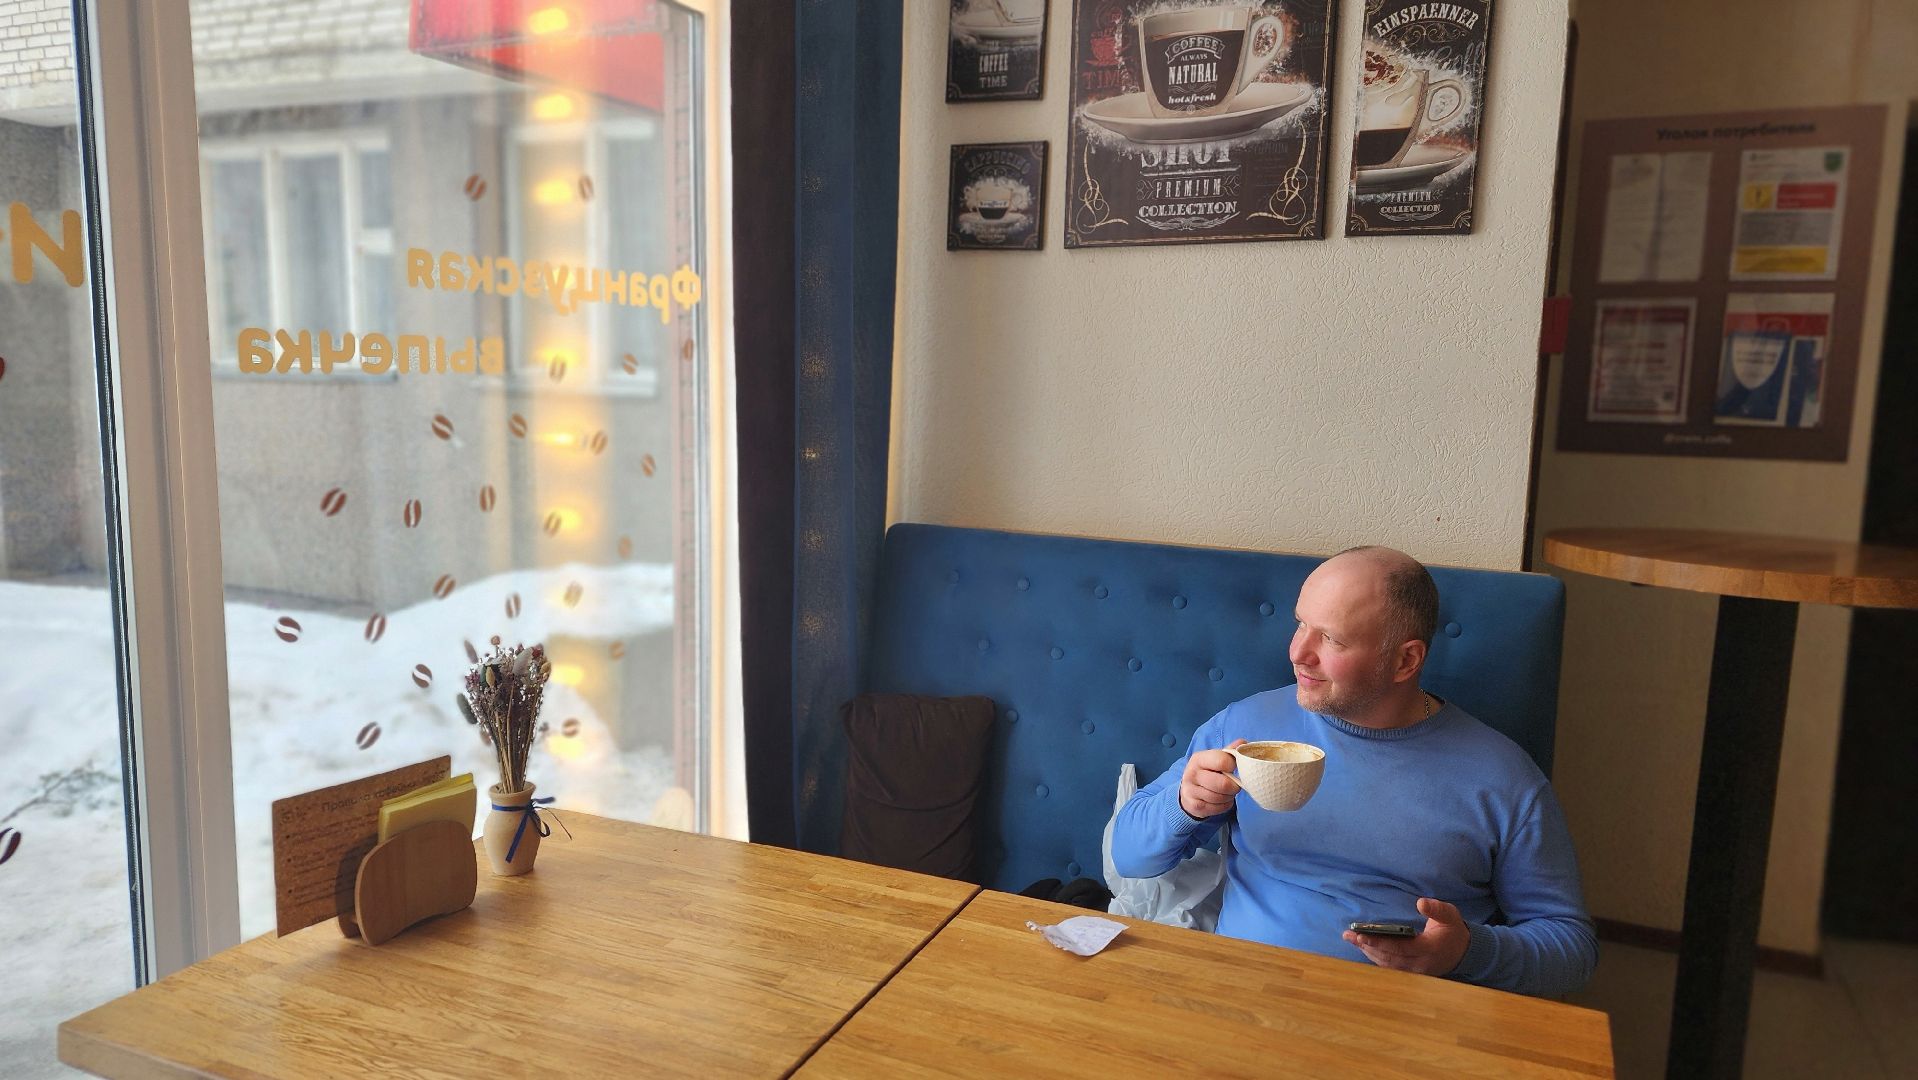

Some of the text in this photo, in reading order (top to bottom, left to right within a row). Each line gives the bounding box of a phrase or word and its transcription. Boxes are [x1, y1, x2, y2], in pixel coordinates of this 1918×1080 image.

[1373, 2, 1479, 38] EINSPAENNER
[1172, 36, 1219, 54] COFFEE
[1180, 53, 1208, 62] ALWAYS
[979, 75, 1008, 89] TIME
[1168, 62, 1218, 86] NATURAL
[1156, 178, 1221, 199] PREMIUM
[1139, 201, 1237, 218] COLLECTION
[1379, 203, 1440, 214] COLLECTION
